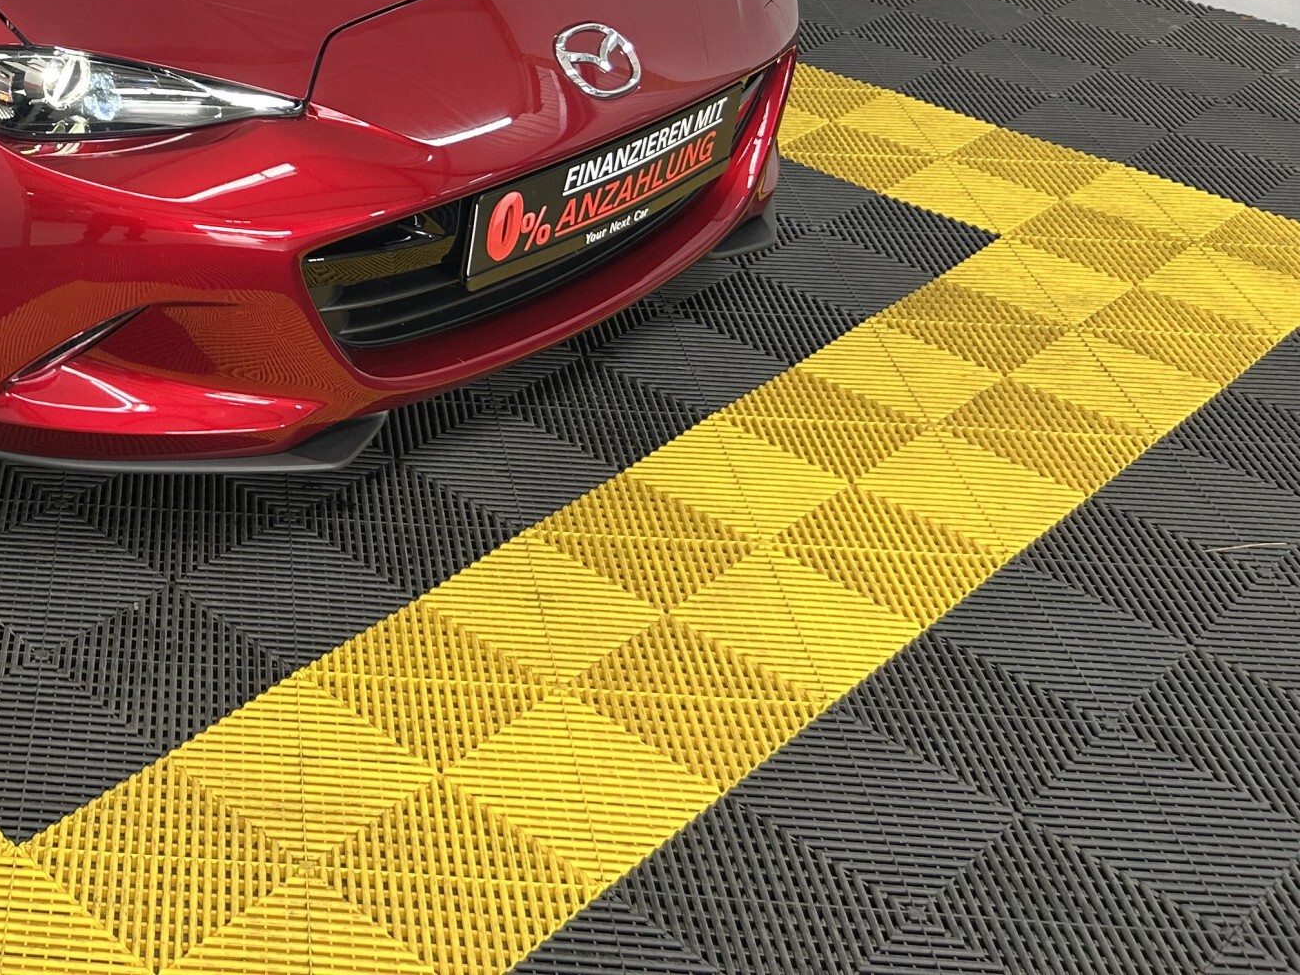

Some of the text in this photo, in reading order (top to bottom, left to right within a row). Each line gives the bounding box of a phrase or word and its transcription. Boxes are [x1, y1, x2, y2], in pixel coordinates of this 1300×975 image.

[564, 97, 728, 193] FINANZIEREN MIT
[486, 131, 717, 262] 0% ANZAHLUNG
[585, 207, 649, 245] Your Next Car
